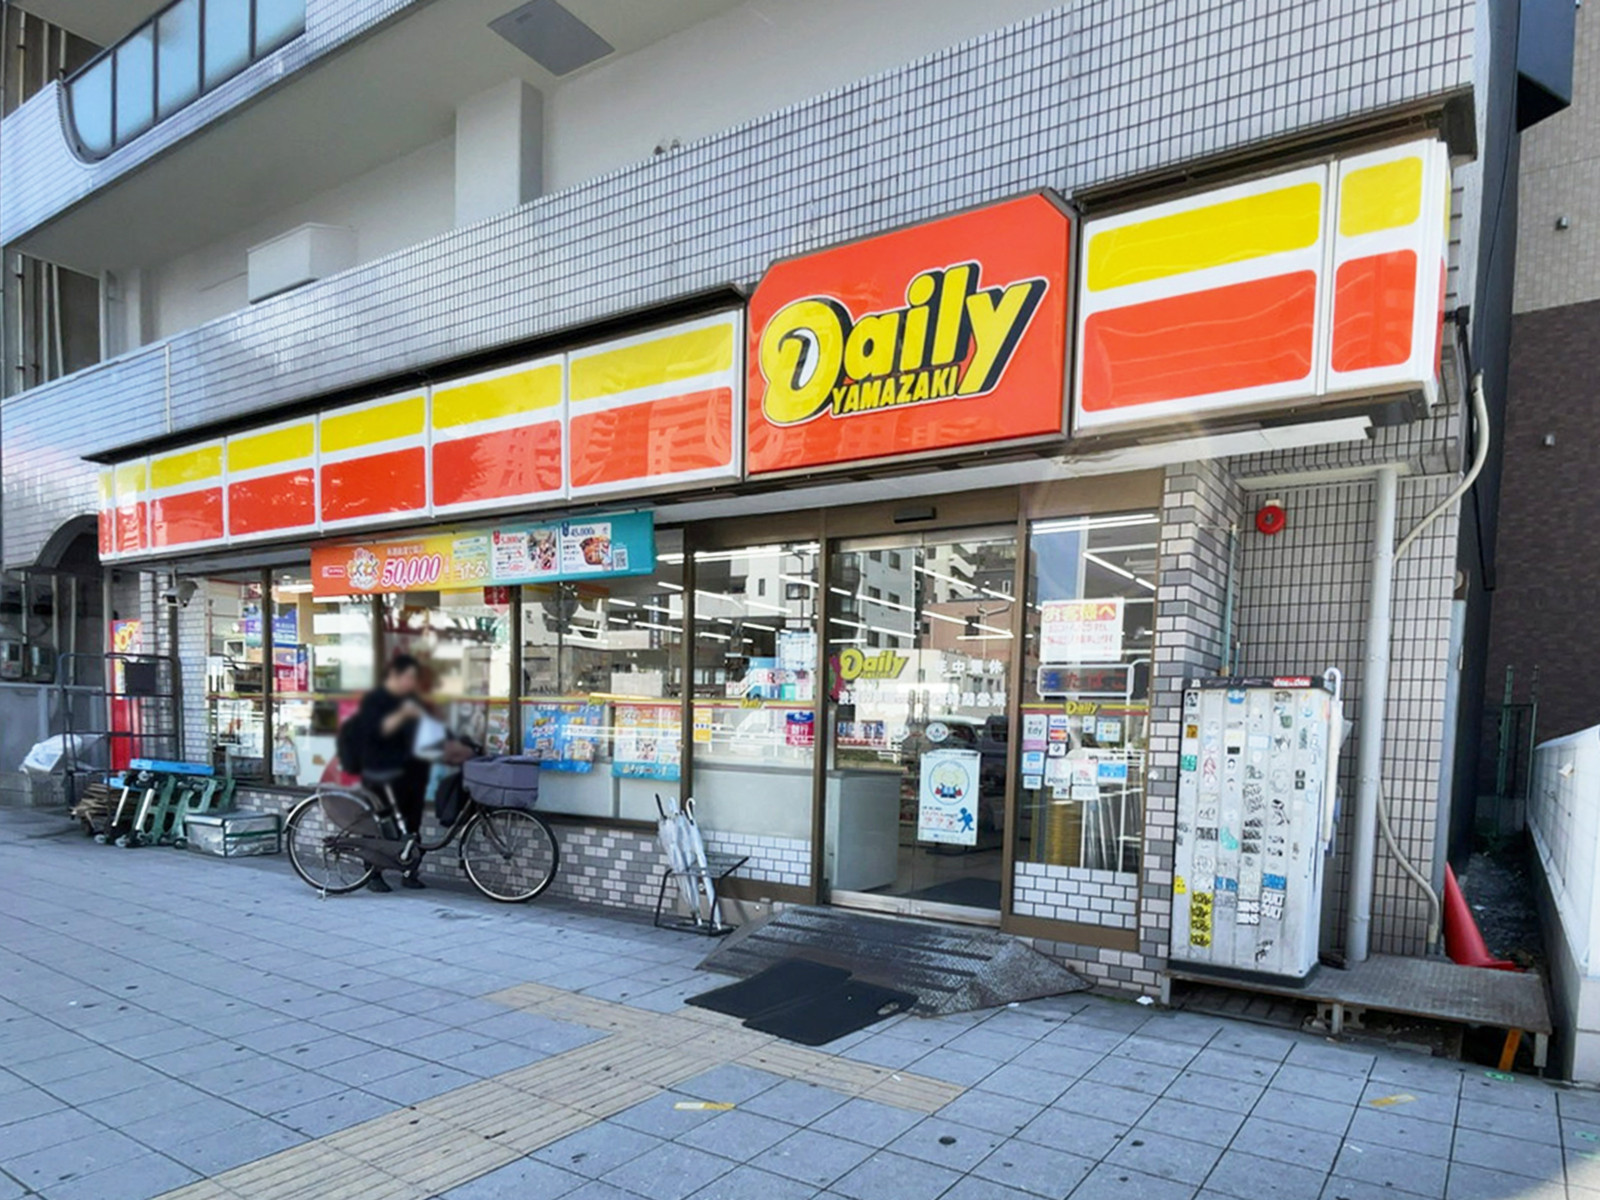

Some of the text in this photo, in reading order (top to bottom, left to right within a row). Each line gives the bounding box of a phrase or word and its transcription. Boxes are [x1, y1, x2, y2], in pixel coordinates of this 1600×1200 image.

[760, 260, 1049, 427] Daily
[831, 365, 960, 415] YAMAZAKI
[381, 554, 442, 590] 50,000
[838, 648, 909, 680] Daily
